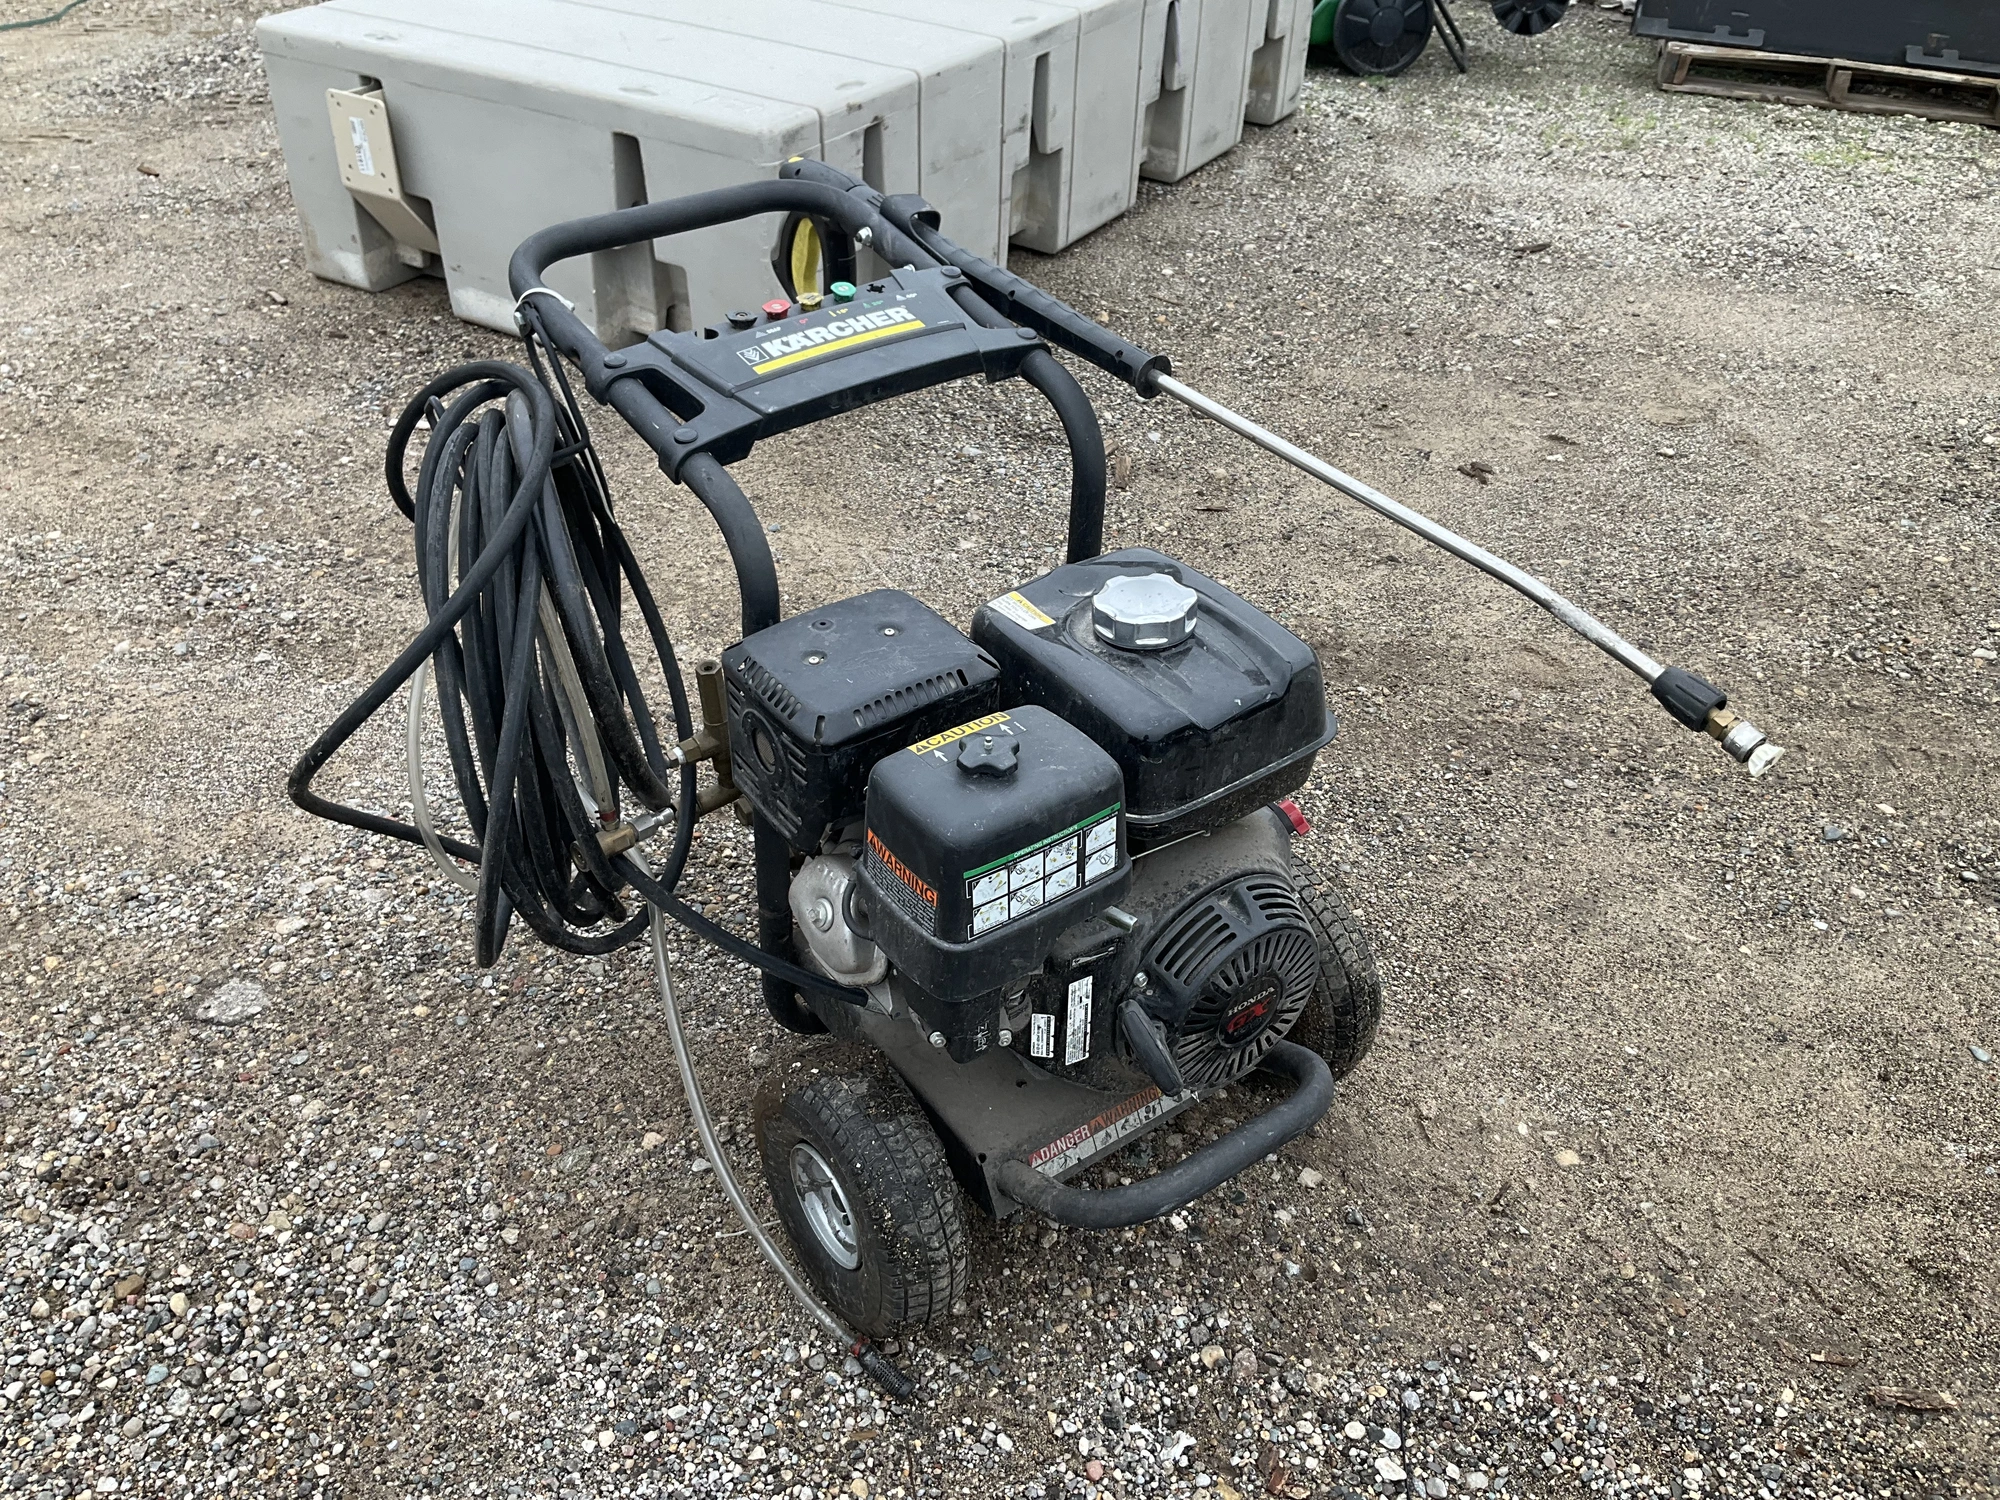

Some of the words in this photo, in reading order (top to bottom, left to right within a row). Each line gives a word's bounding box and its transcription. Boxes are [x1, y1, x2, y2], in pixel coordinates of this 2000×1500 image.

[761, 306, 917, 358] KÄRCHER
[925, 713, 1008, 747] CAUTION
[1013, 839, 1043, 858] OPERATING
[1043, 824, 1078, 846] INSTRUCTIONS
[873, 836, 936, 906] WARNING
[1226, 996, 1272, 1033] GX
[1227, 986, 1275, 1017] HONDA
[1040, 1124, 1091, 1161] DANGER
[1101, 1086, 1159, 1126] WARNING
